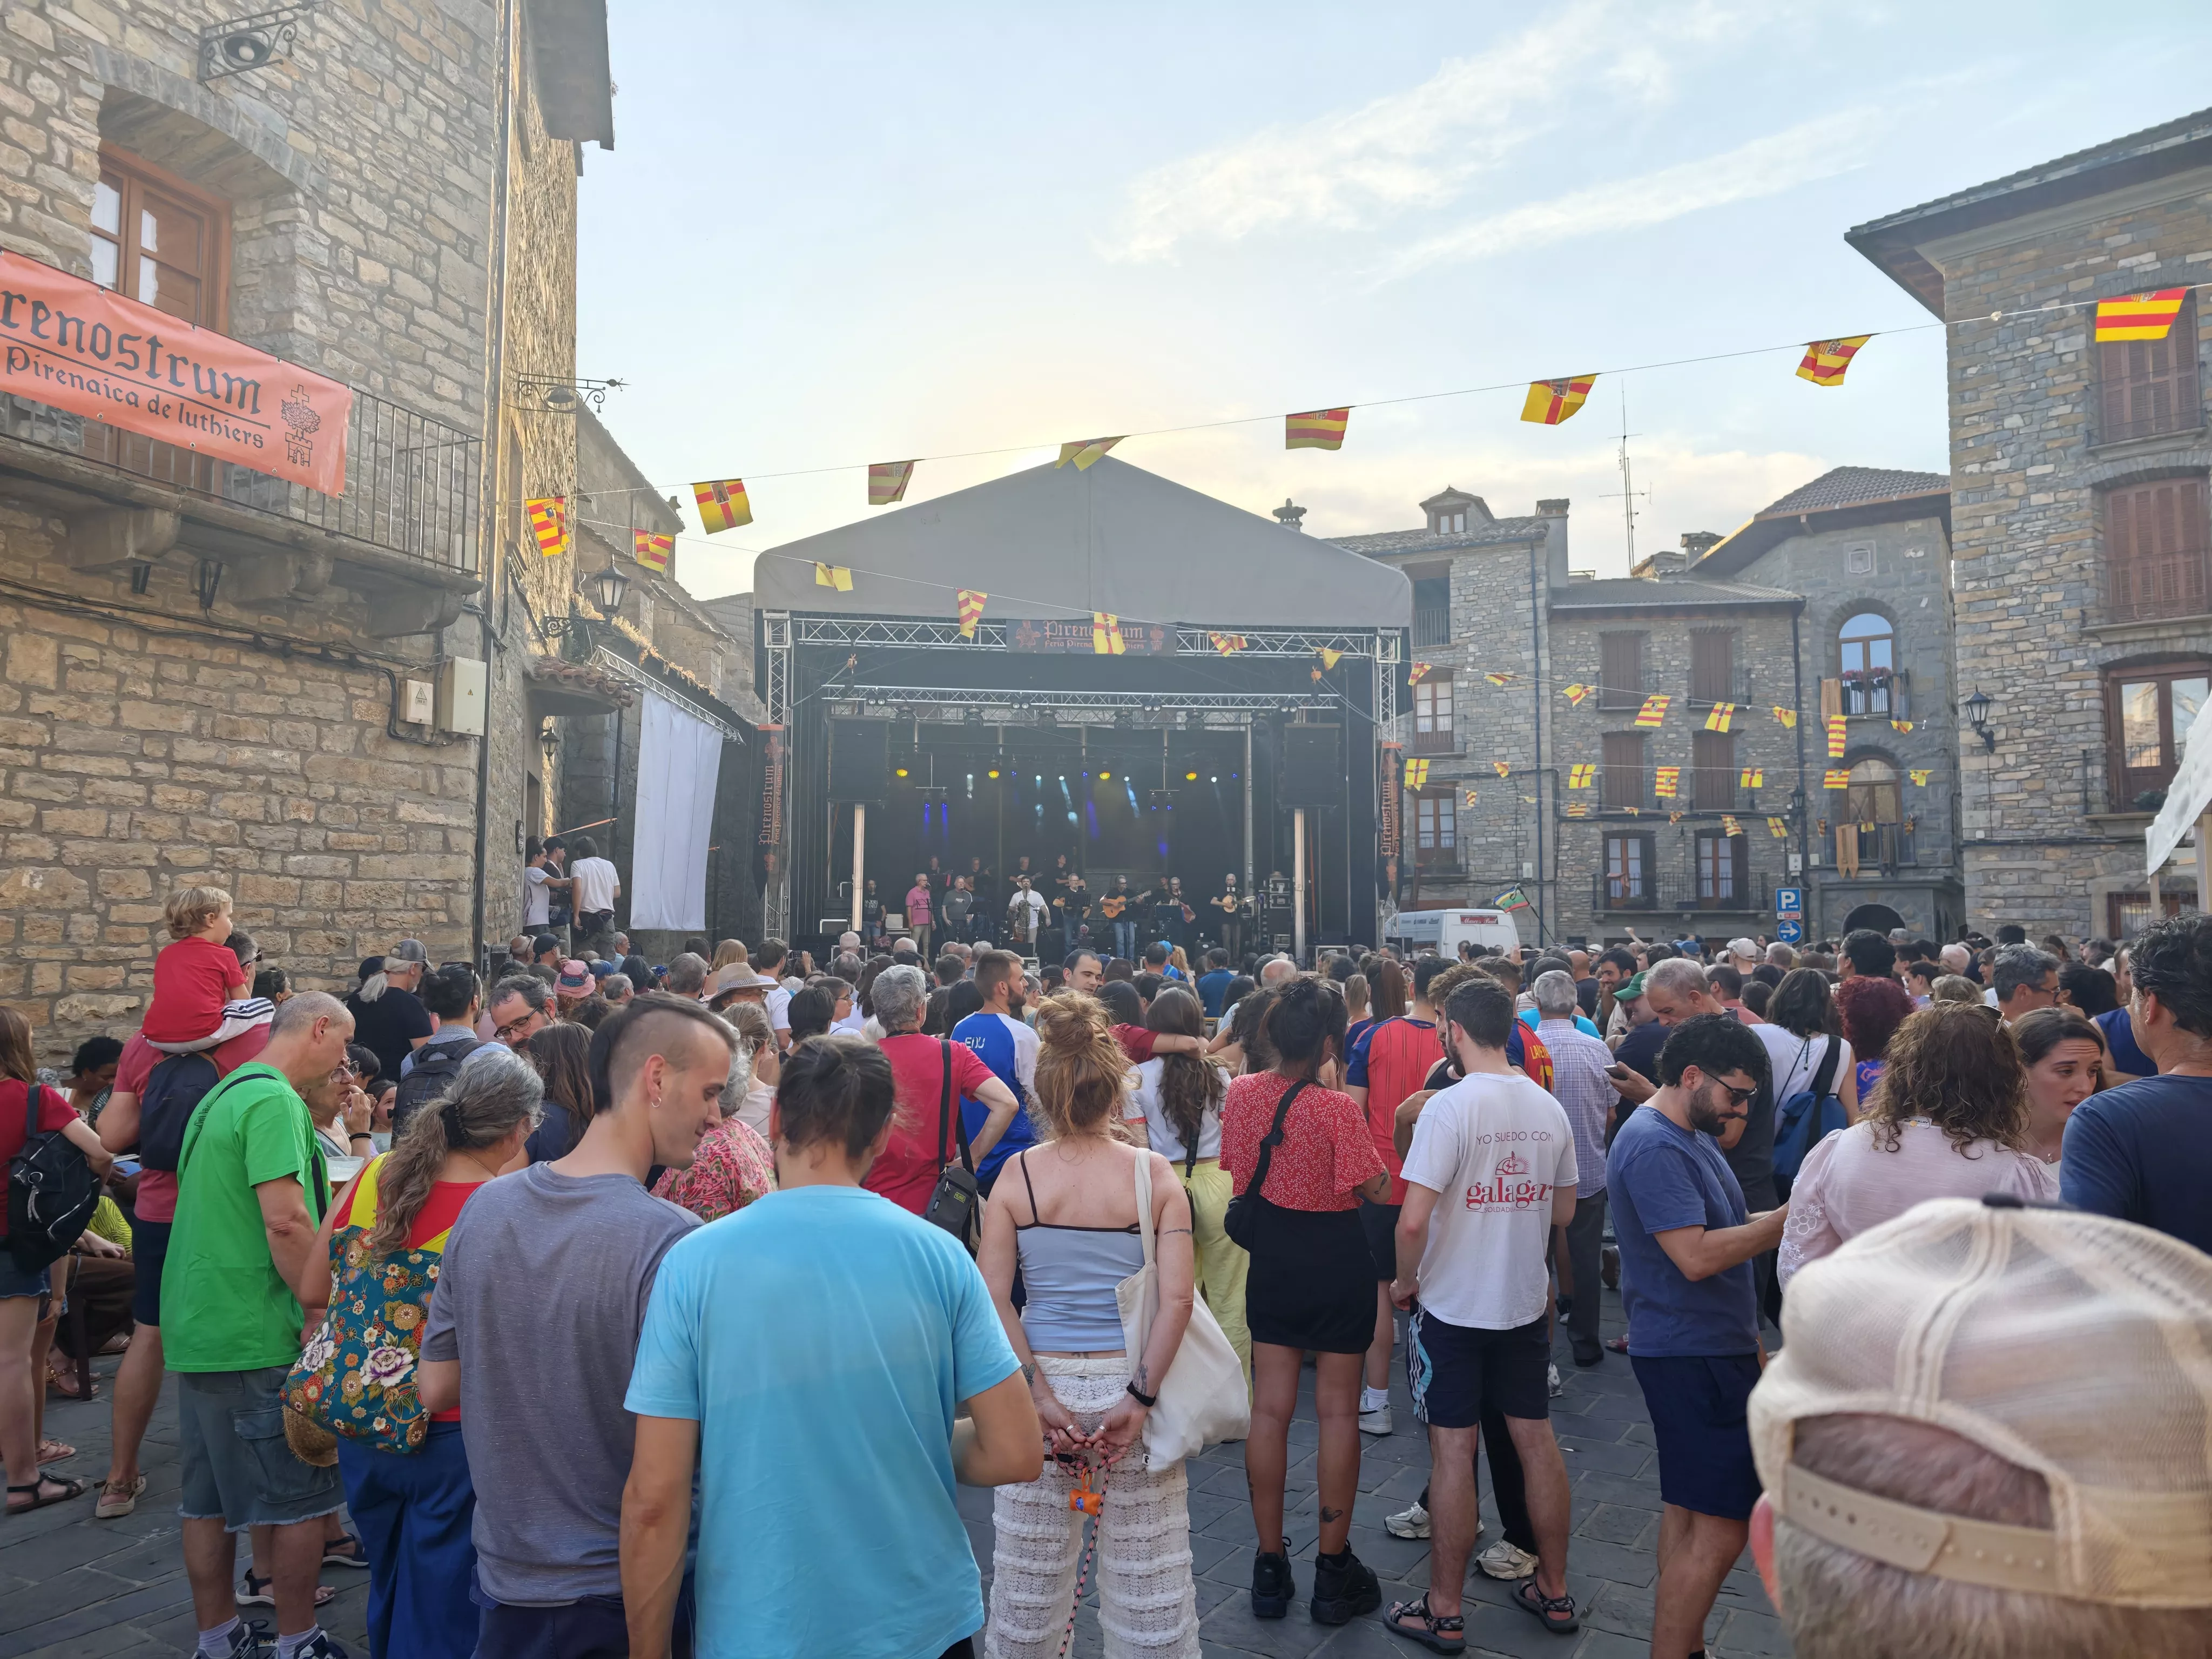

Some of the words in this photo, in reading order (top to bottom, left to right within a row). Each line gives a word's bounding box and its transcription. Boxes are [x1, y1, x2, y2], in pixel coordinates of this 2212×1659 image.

[6, 347, 139, 408] Pirenaica
[147, 394, 171, 419] de
[179, 404, 264, 449] luthiers
[758, 765, 774, 845] Pirenostrum
[1380, 781, 1394, 857] Pirenostrum
[1781, 891, 1796, 909] P
[1476, 1134, 1492, 1145] YO
[1532, 1131, 1554, 1142] CON
[1466, 1177, 1553, 1210] galagar
